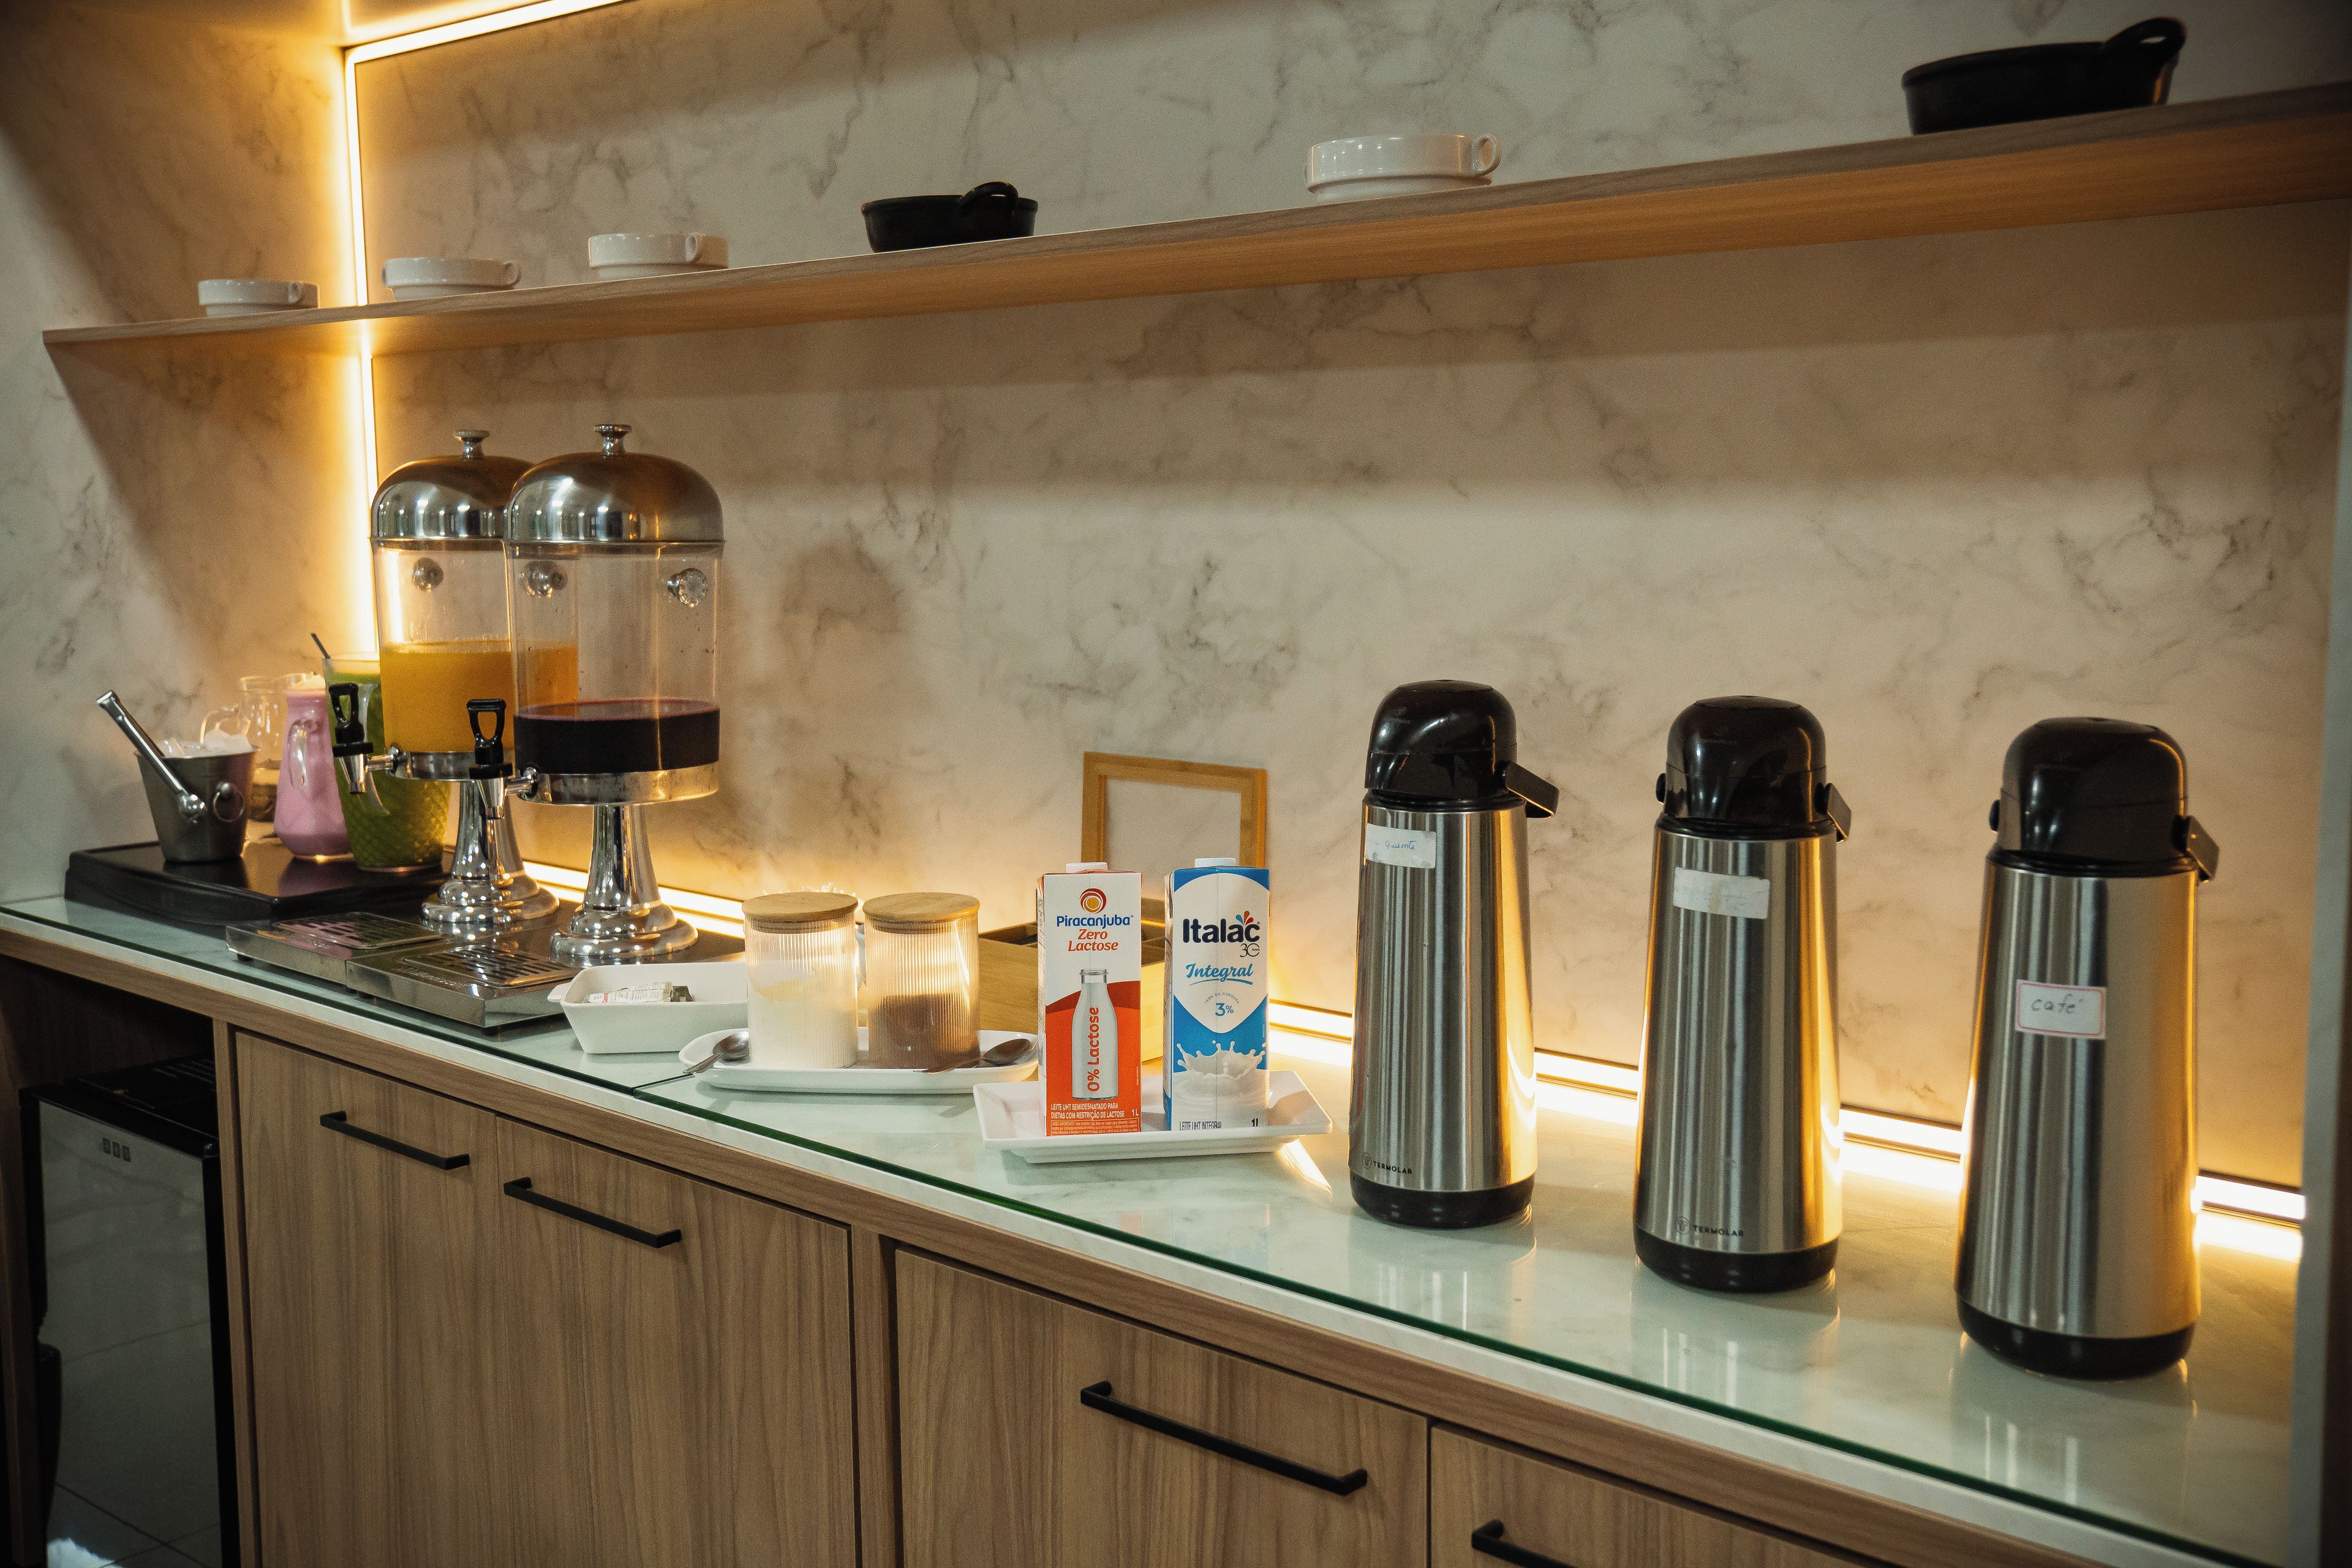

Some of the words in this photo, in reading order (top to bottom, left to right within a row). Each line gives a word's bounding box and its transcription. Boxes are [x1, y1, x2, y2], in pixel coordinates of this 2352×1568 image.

[1057, 914, 1130, 929] Piracanjuba
[1078, 929, 1107, 940] Zero
[1183, 918, 1260, 943] Italac
[1068, 941, 1118, 951] Lactose
[1186, 963, 1253, 982] Integral
[1215, 1003, 1234, 1016] 3%
[1087, 1007, 1099, 1065] Lactose
[1087, 1069, 1099, 1091] 0%
[1076, 1110, 1099, 1120] RESTRIÇÃO
[1373, 1160, 1412, 1174] TERMOLAR
[1694, 1225, 1744, 1236] TERMOLAR
